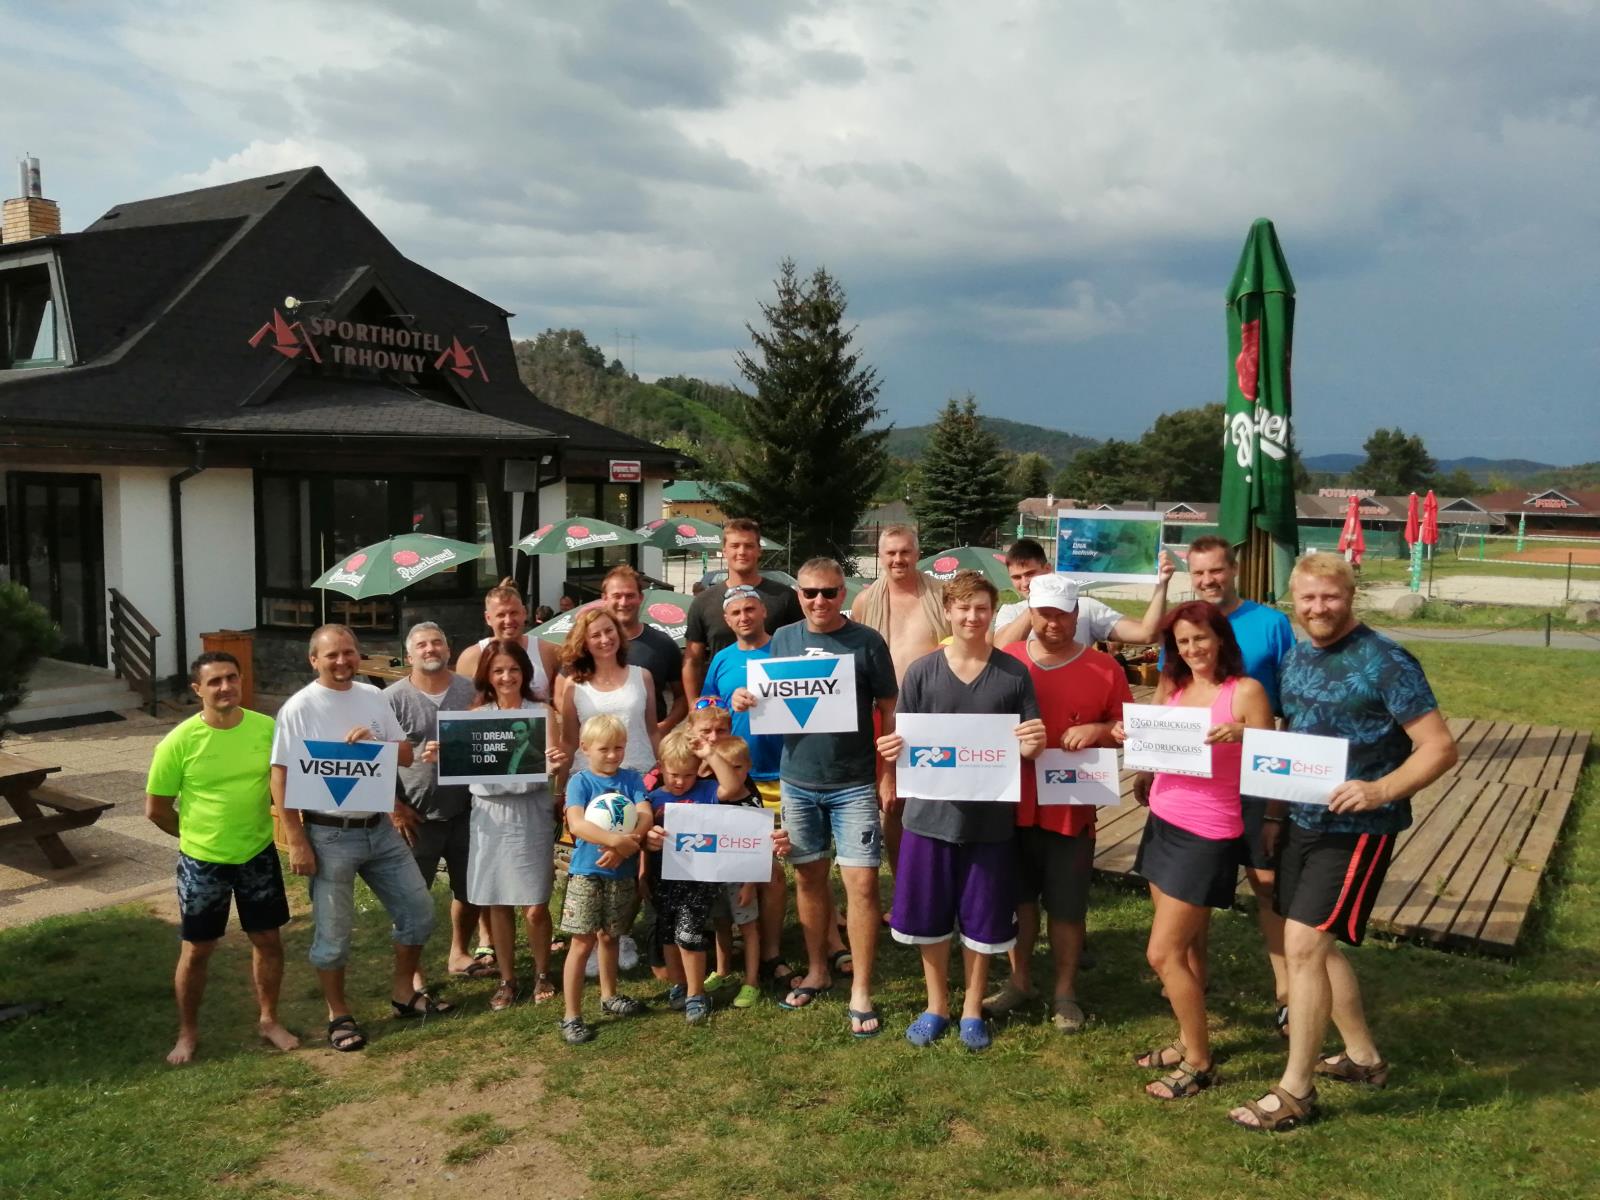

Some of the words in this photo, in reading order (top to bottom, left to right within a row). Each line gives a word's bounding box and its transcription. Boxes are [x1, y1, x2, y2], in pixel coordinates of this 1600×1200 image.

[311, 317, 442, 351] SPORTHOTEL
[331, 345, 426, 373] TRHOVKY
[758, 678, 839, 698] VISHAY
[1140, 719, 1152, 727] GD
[1153, 720, 1201, 729] DRUCKGUSS
[471, 731, 482, 740] TO
[483, 731, 516, 740] DREAM.
[471, 743, 482, 752] TO
[483, 743, 508, 752] DARE.
[958, 746, 1007, 762] ČHSF
[1142, 742, 1154, 750] GD
[1155, 743, 1202, 753] DRUCKGUSS
[471, 755, 482, 763] TO
[484, 754, 498, 763] DO.
[299, 759, 380, 777] VISHAY
[1292, 759, 1334, 775] ČHSF
[719, 834, 762, 849] ČHSF
